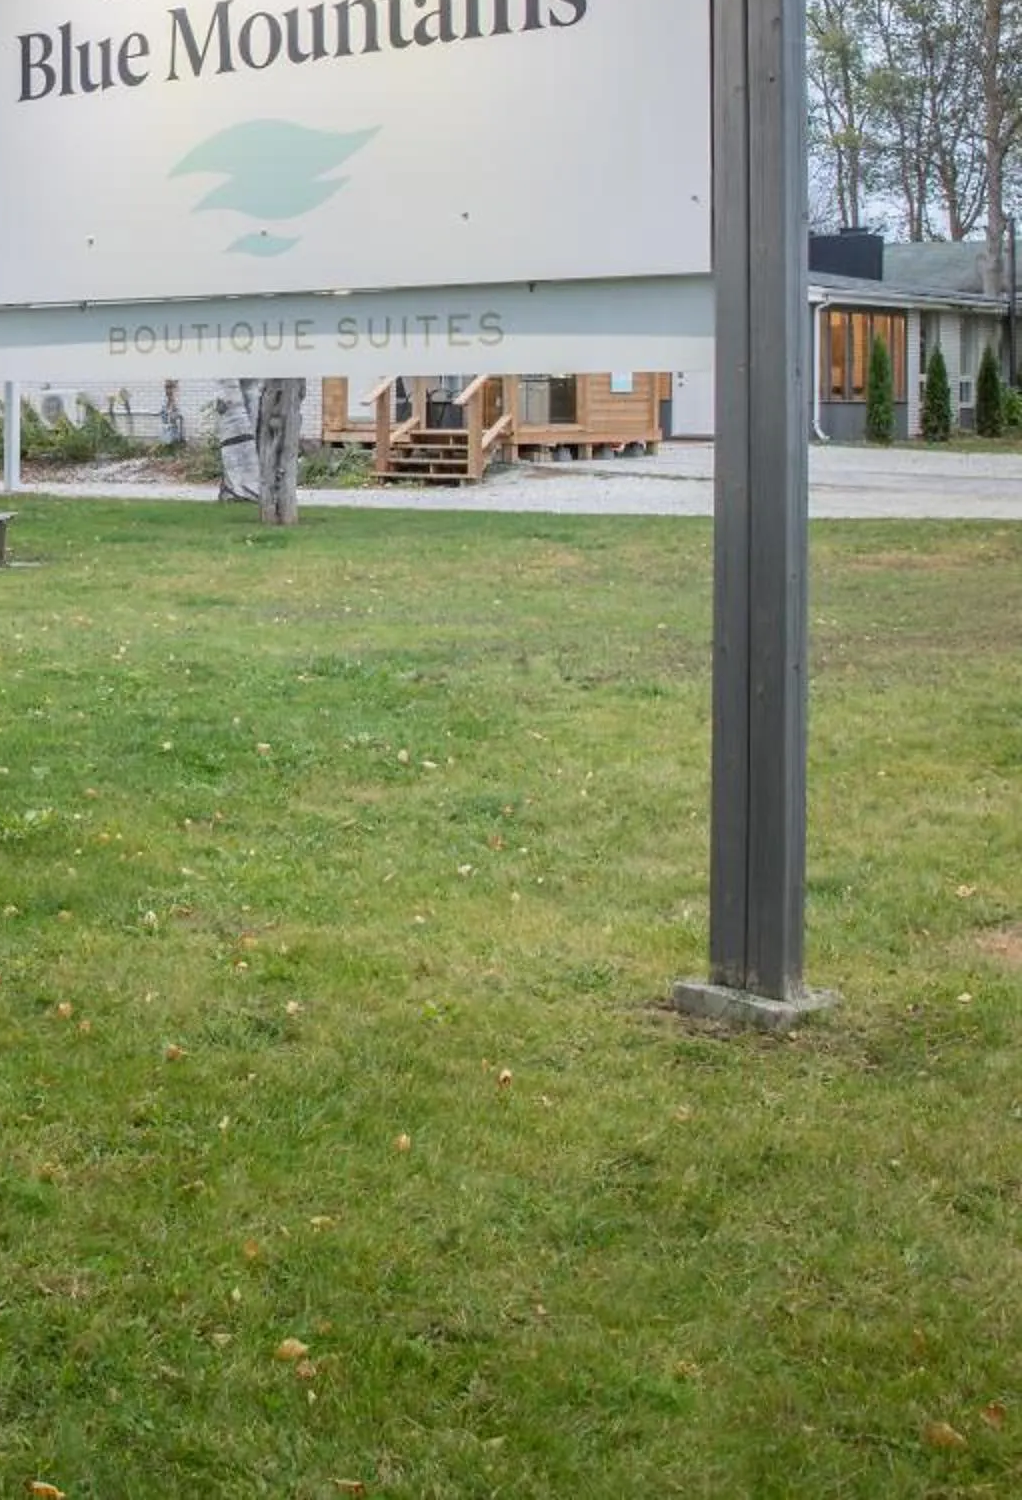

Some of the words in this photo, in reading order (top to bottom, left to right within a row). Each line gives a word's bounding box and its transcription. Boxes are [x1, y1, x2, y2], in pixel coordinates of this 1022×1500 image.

[15, 21, 150, 103] Blue
[109, 319, 315, 355] BOUTIQUE
[337, 312, 504, 350] SUITES
